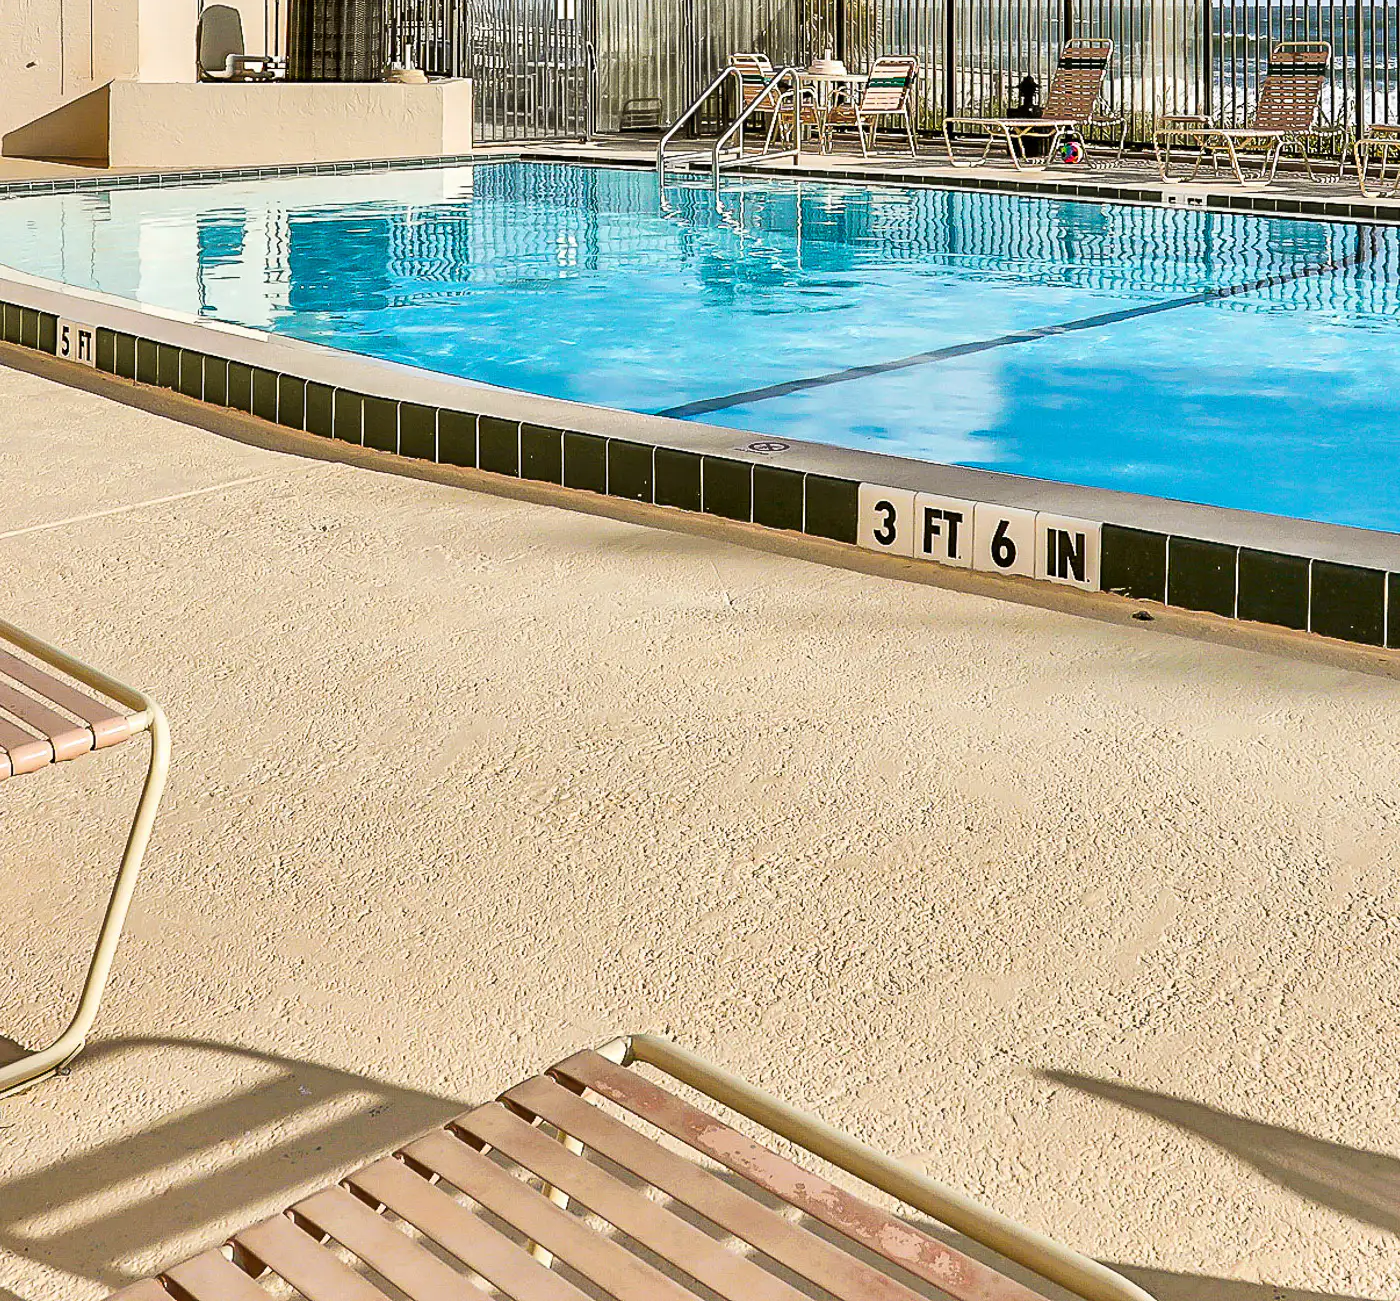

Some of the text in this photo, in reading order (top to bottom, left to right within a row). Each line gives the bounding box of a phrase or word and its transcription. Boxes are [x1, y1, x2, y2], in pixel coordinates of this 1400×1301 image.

[61, 325, 92, 362] 5 FT
[873, 500, 897, 546] 3
[990, 519, 1017, 568] 6
